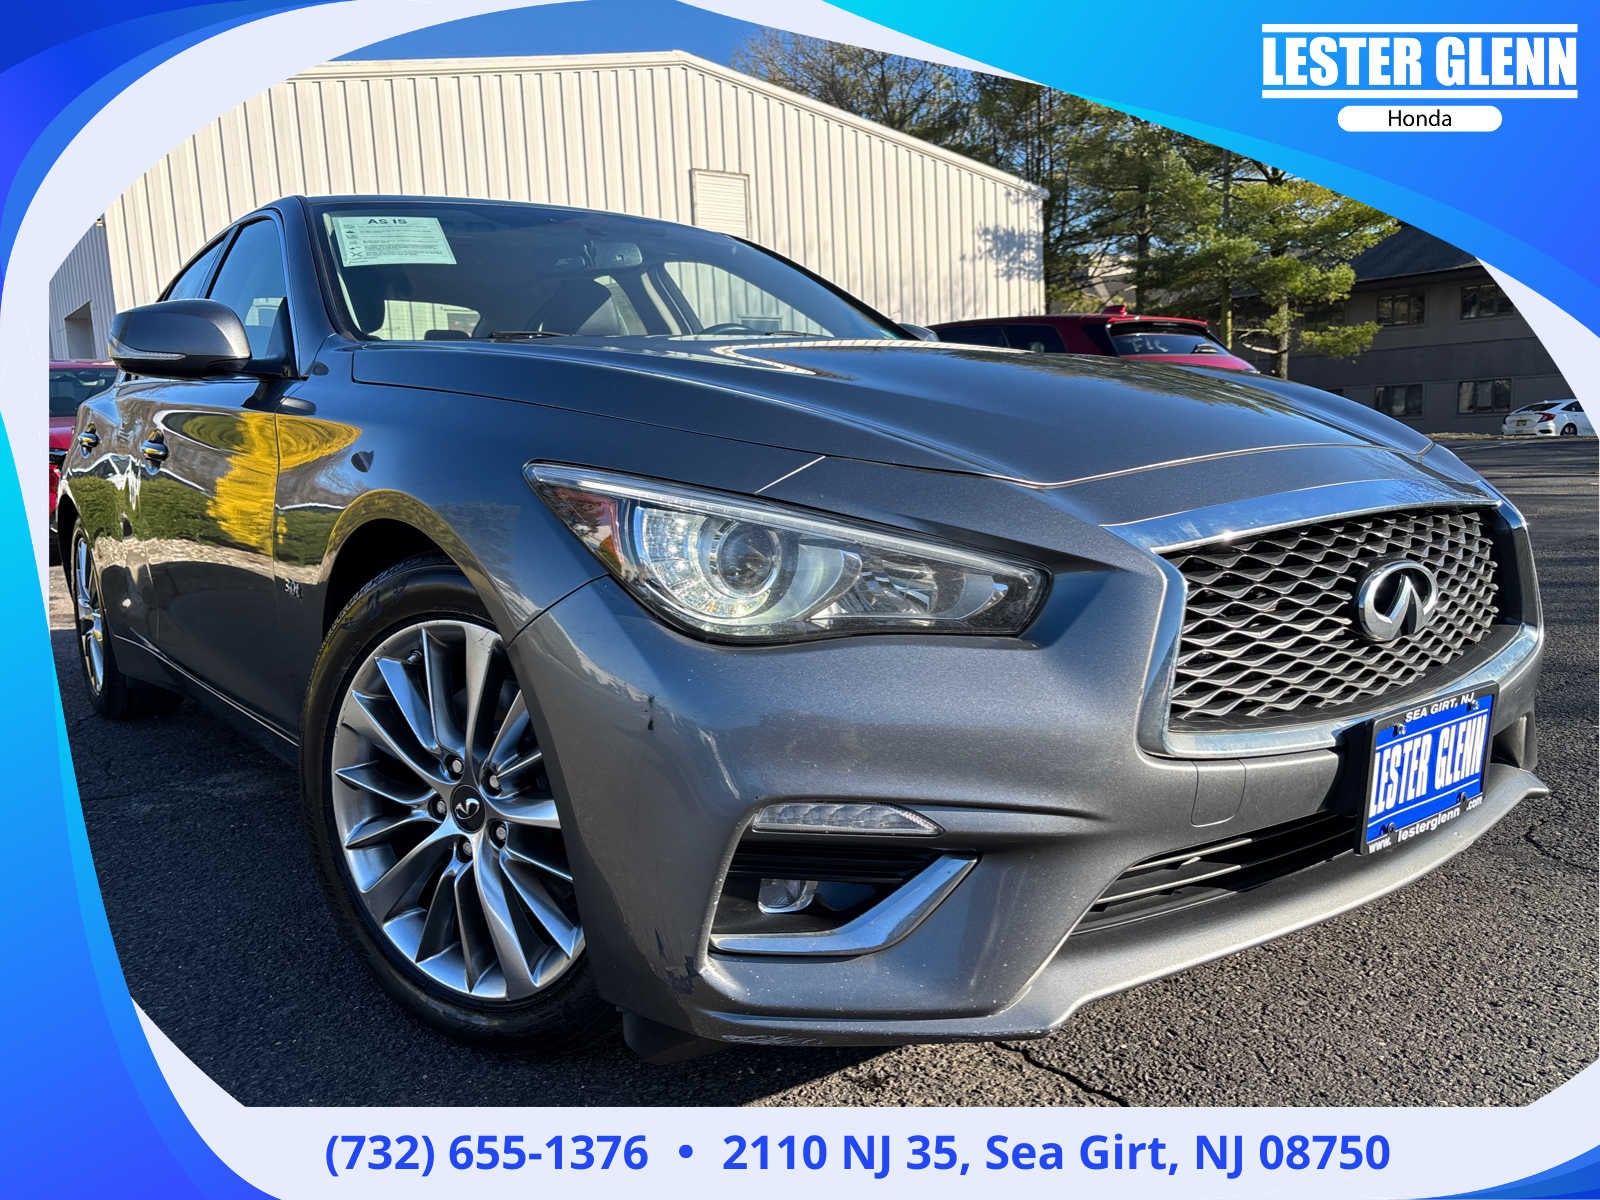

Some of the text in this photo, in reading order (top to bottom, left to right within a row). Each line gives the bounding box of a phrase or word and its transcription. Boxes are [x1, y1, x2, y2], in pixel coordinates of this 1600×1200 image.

[1405, 709, 1427, 723] SEA
[1430, 698, 1458, 715] GIRT,
[1369, 714, 1488, 819] LESTER GLENN
